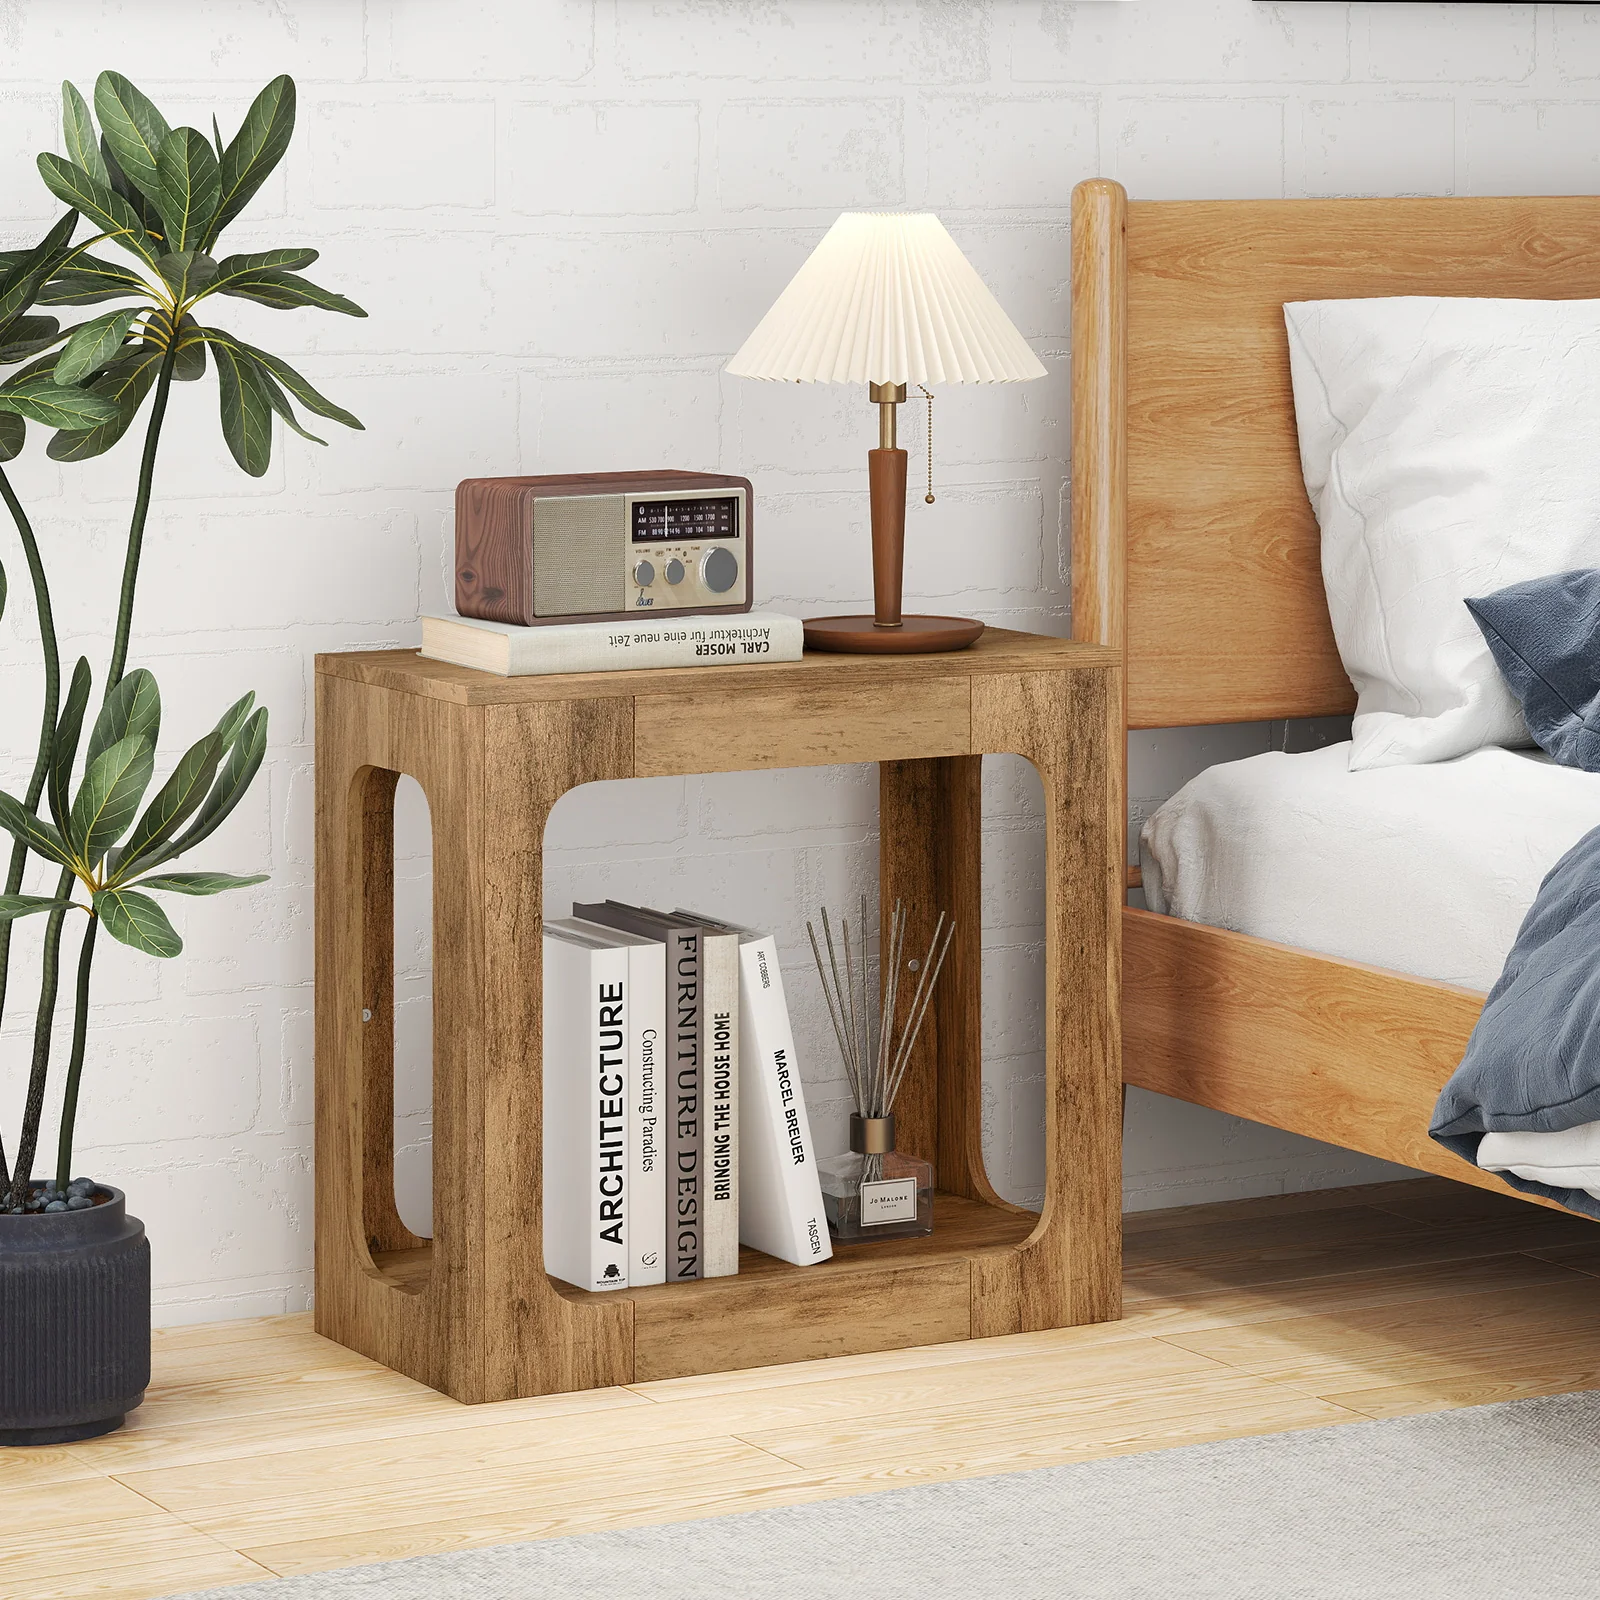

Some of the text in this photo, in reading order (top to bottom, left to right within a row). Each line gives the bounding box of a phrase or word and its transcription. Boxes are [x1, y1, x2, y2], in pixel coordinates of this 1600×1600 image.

[609, 628, 770, 647] Architektur für eine neue Zeit
[696, 641, 769, 656] CARL MOSER
[600, 982, 623, 1244] ARCHITECTURE
[639, 1029, 657, 1172] Constructing Paradies
[678, 934, 698, 1278] FURNITURE DESIGN
[714, 1012, 730, 1200] BRINGING THE HOUSE HOME
[774, 1049, 805, 1166] MARCEL BREUER
[807, 1217, 821, 1255] TASCEN
